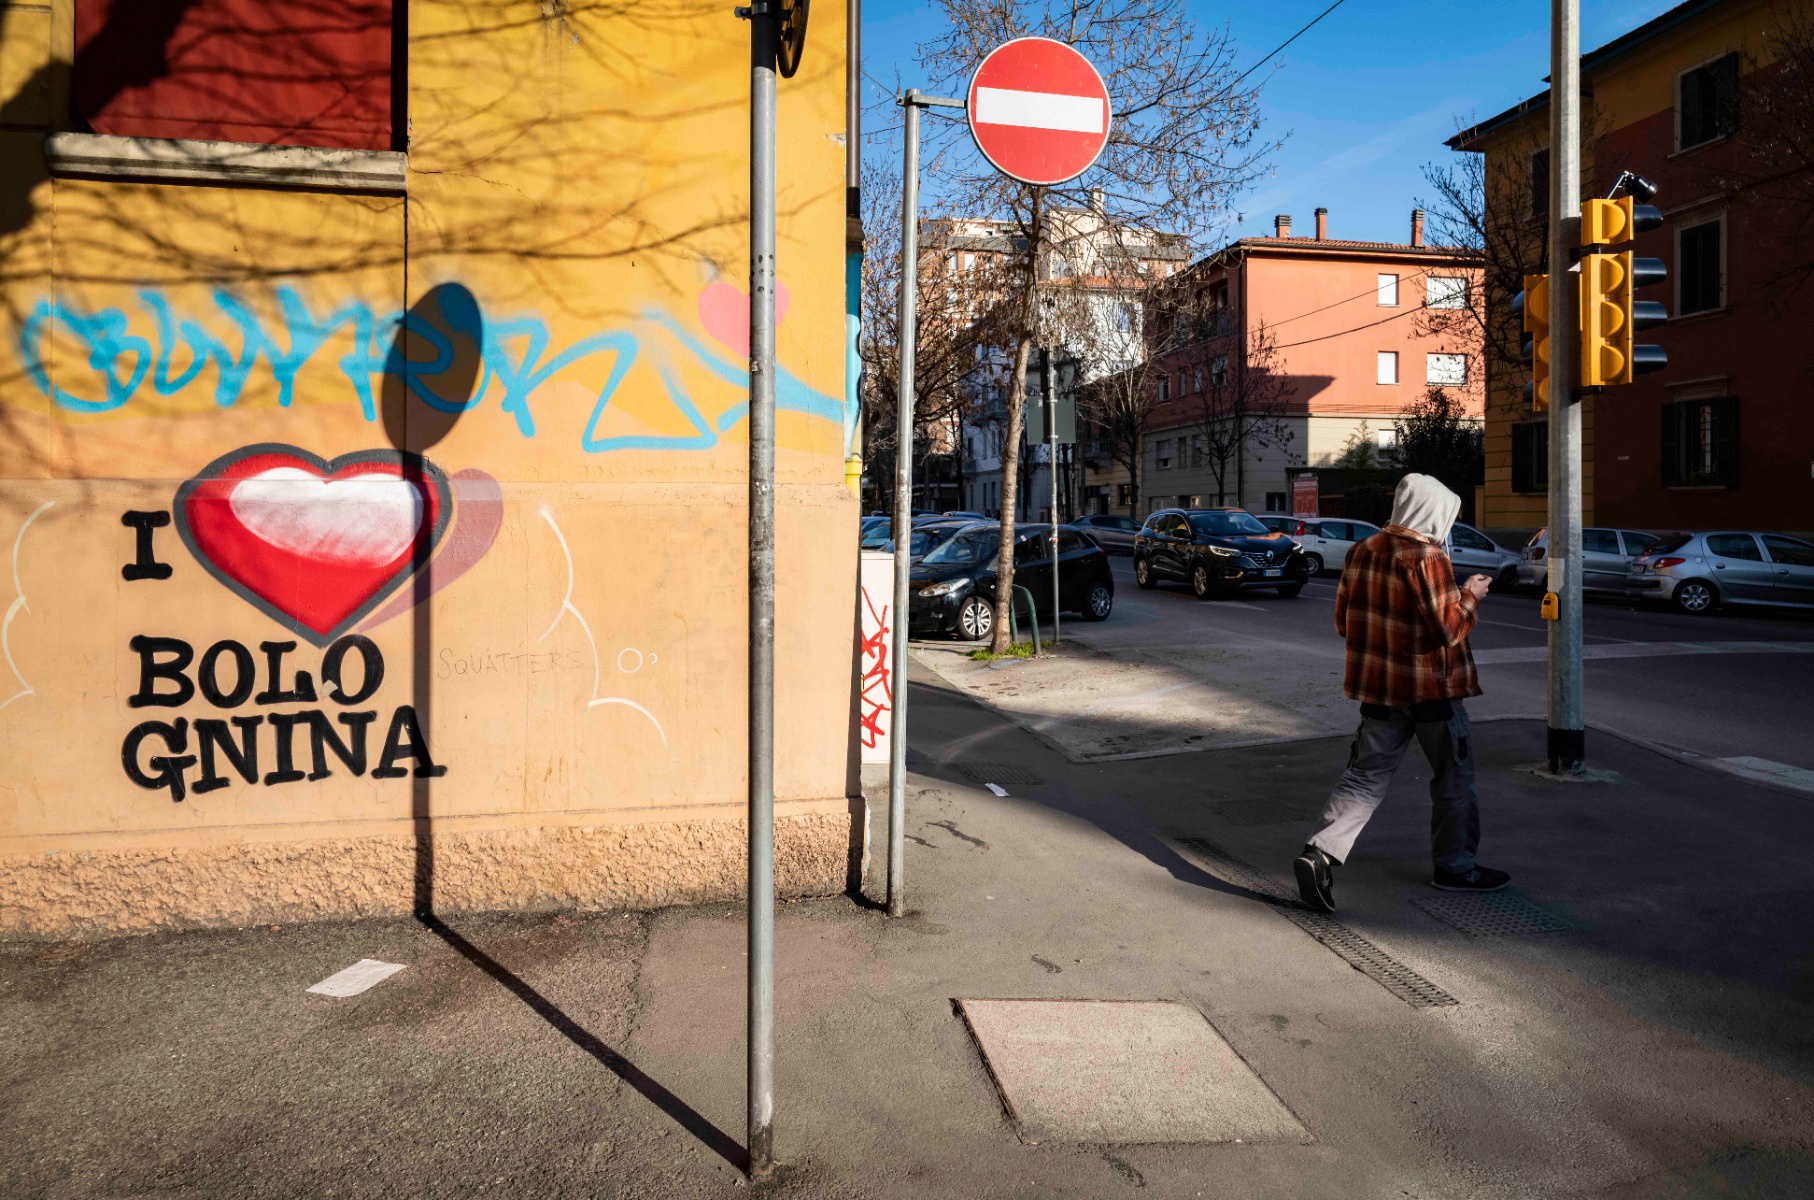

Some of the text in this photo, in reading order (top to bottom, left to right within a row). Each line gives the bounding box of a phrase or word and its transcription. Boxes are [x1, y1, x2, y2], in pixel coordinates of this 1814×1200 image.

[121, 510, 173, 581] I
[128, 634, 385, 708] BOLO
[437, 647, 585, 681] SQUATTERS
[121, 705, 448, 802] GNINA
